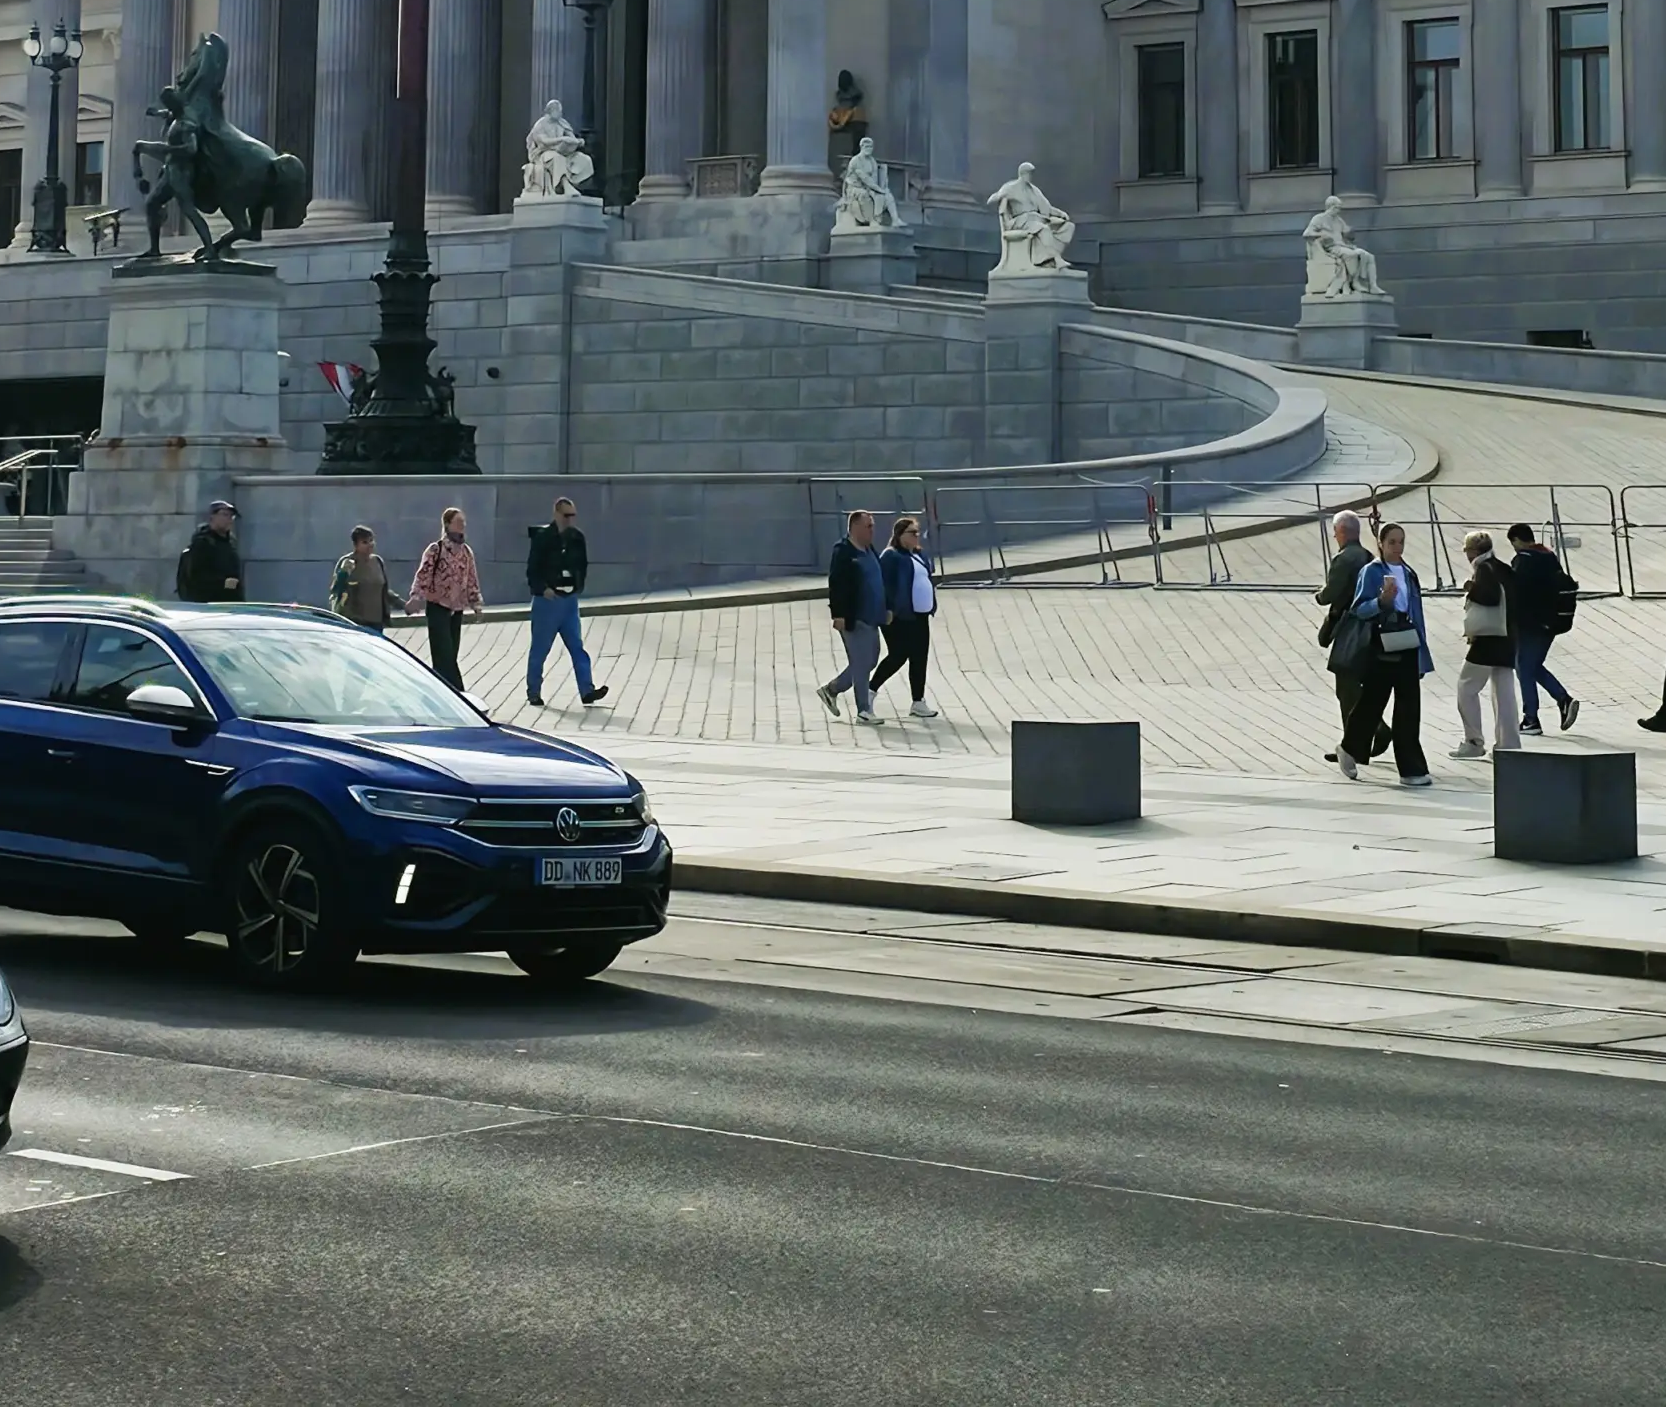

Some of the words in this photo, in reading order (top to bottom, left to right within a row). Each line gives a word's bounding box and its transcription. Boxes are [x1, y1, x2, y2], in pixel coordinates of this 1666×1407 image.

[544, 861, 563, 881] DD
[574, 861, 592, 881] NK
[595, 861, 621, 881] 889
